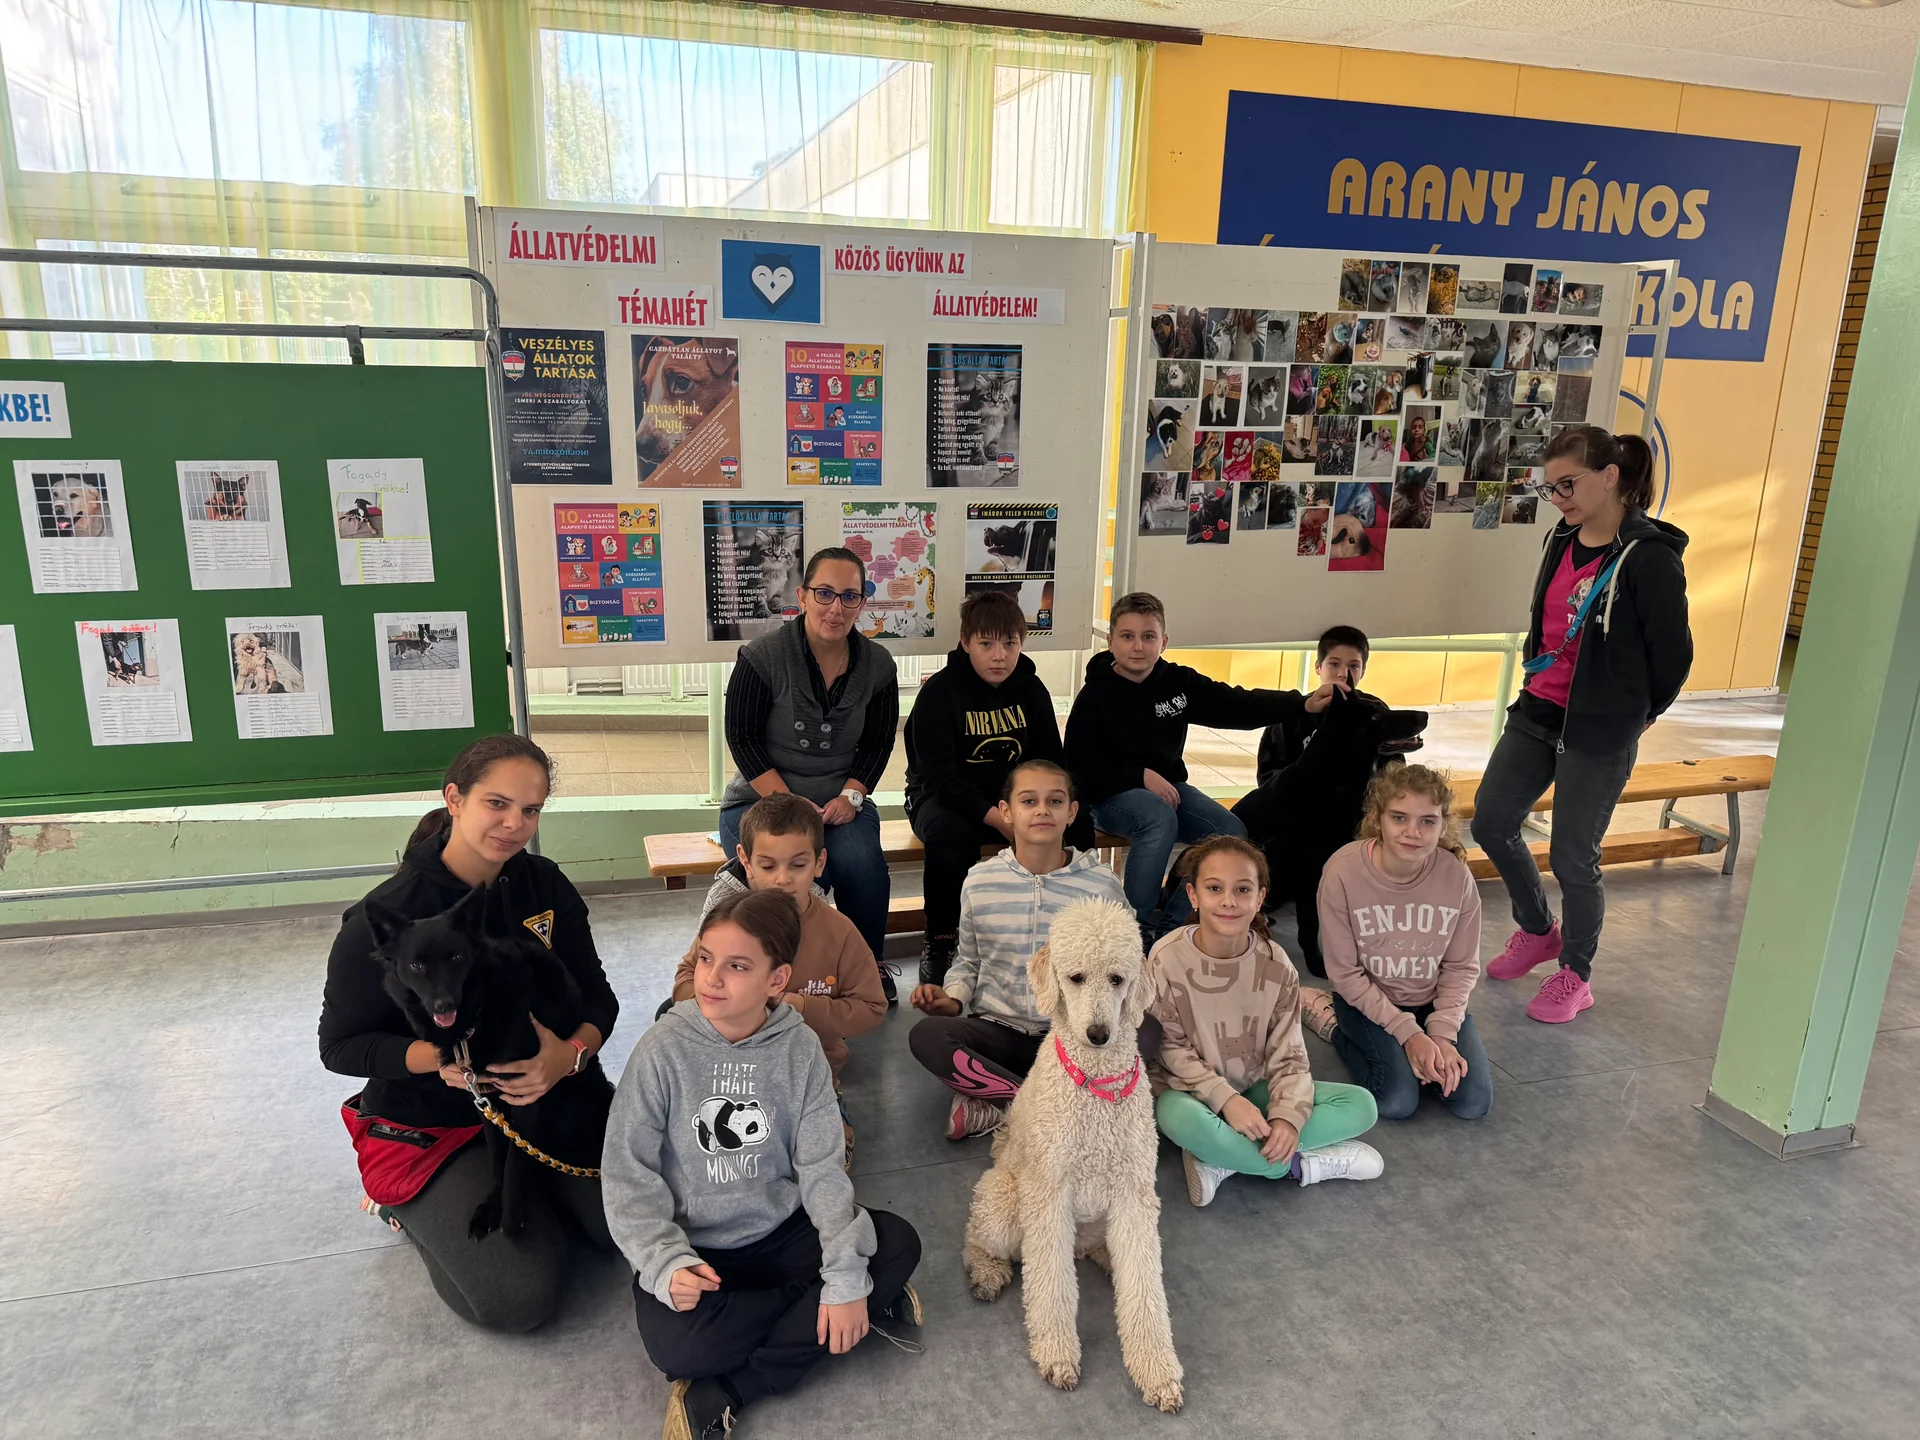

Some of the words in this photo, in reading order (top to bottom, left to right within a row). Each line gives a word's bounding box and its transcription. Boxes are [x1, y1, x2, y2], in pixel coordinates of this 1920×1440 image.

[1326, 157, 1524, 226] ARANY
[1536, 160, 1710, 240] JÁNOS
[508, 221, 656, 264] ÁLLATVÉDELMI
[835, 244, 880, 271] KÖZÖS
[885, 246, 944, 273] ÜGYÜNK
[948, 253, 965, 274] AZ
[618, 288, 708, 326] TÉMAHÉT
[933, 289, 1038, 318] ÁLLATVÉDELEM!
[518, 336, 595, 351] VESZÉLYES
[649, 345, 690, 353] GAZDÁTLAN
[691, 346, 723, 354] ÁLLATOT
[533, 350, 595, 365] ÁLLATOK
[789, 349, 807, 363] 10
[534, 365, 597, 379] TARTÁSA
[0, 393, 51, 422] KBE!
[642, 400, 703, 419] Javasoljuk,
[655, 414, 692, 434] hogy...
[558, 510, 579, 524] 10
[981, 509, 1003, 517] IMÁDOK
[964, 704, 1027, 736] NIRVANA
[1353, 903, 1460, 937] ENJOY
[812, 986, 832, 995] cool
